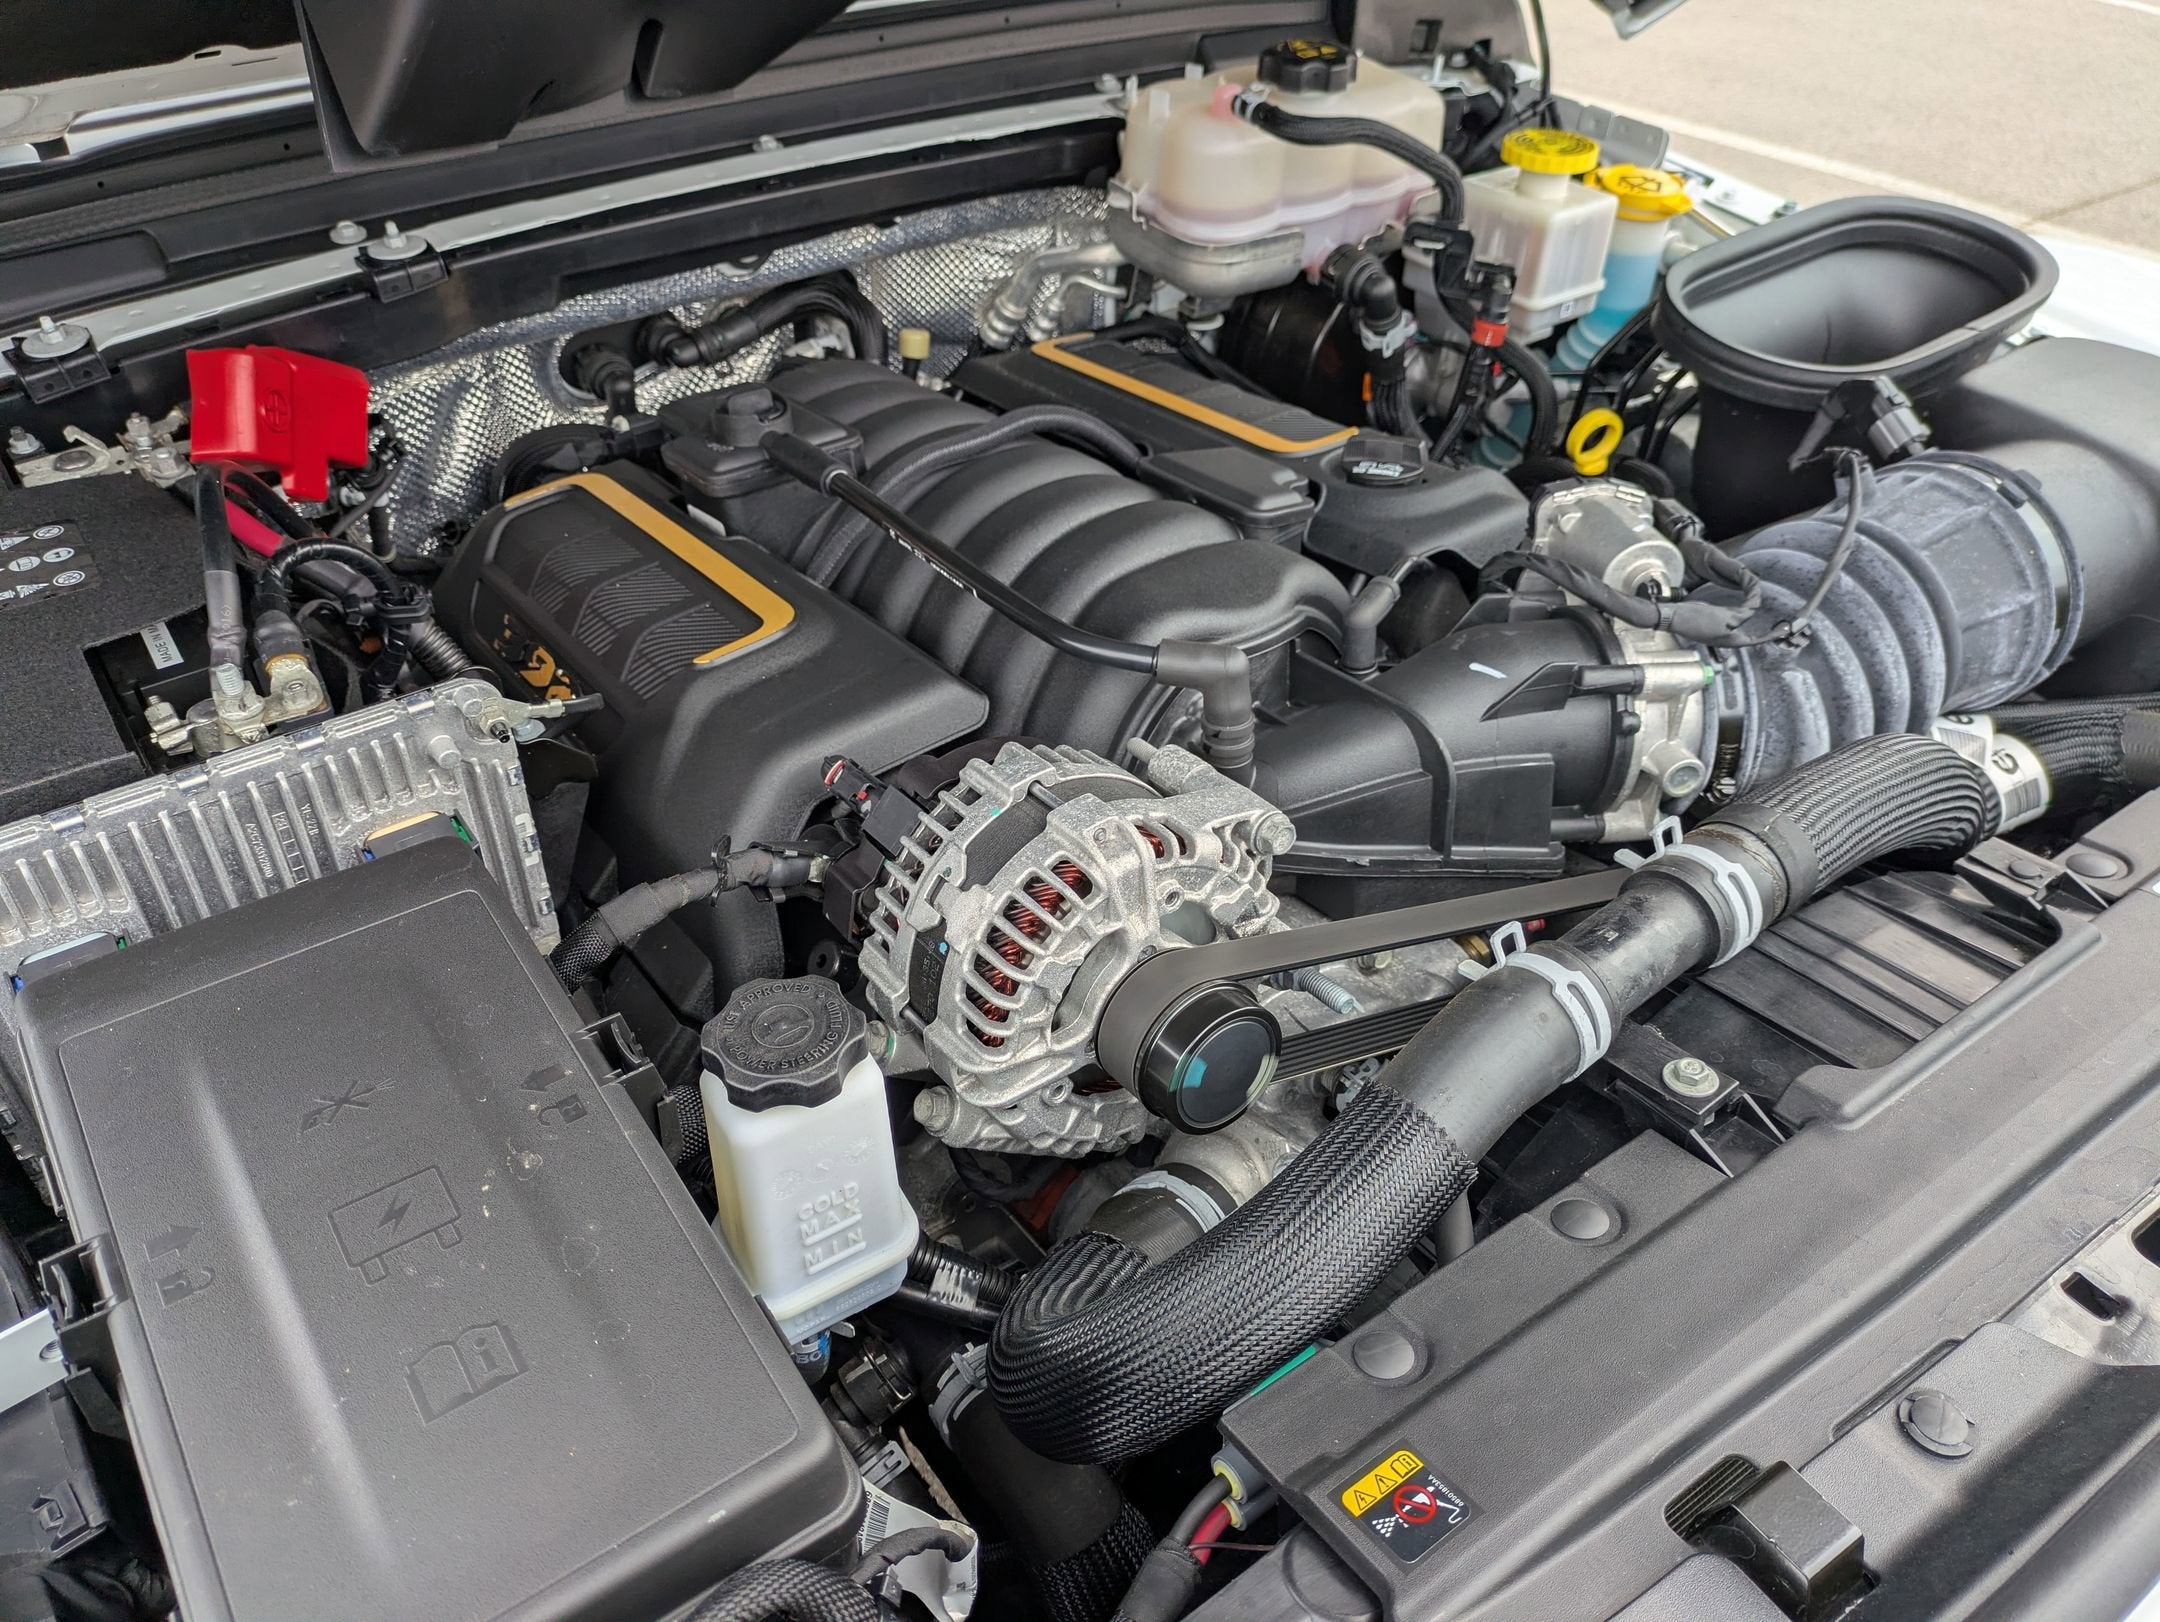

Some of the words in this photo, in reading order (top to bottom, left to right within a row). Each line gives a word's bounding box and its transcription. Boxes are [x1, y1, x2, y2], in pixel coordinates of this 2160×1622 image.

[154, 641, 173, 663] MADE
[739, 982, 812, 1011] APPROVED
[730, 1045, 777, 1070] POWER
[780, 1031, 838, 1069] STEERING
[826, 1000, 843, 1029] FLUID
[798, 1181, 859, 1220] COLD
[800, 1198, 862, 1240] MAX
[803, 1227, 864, 1268] MIN
